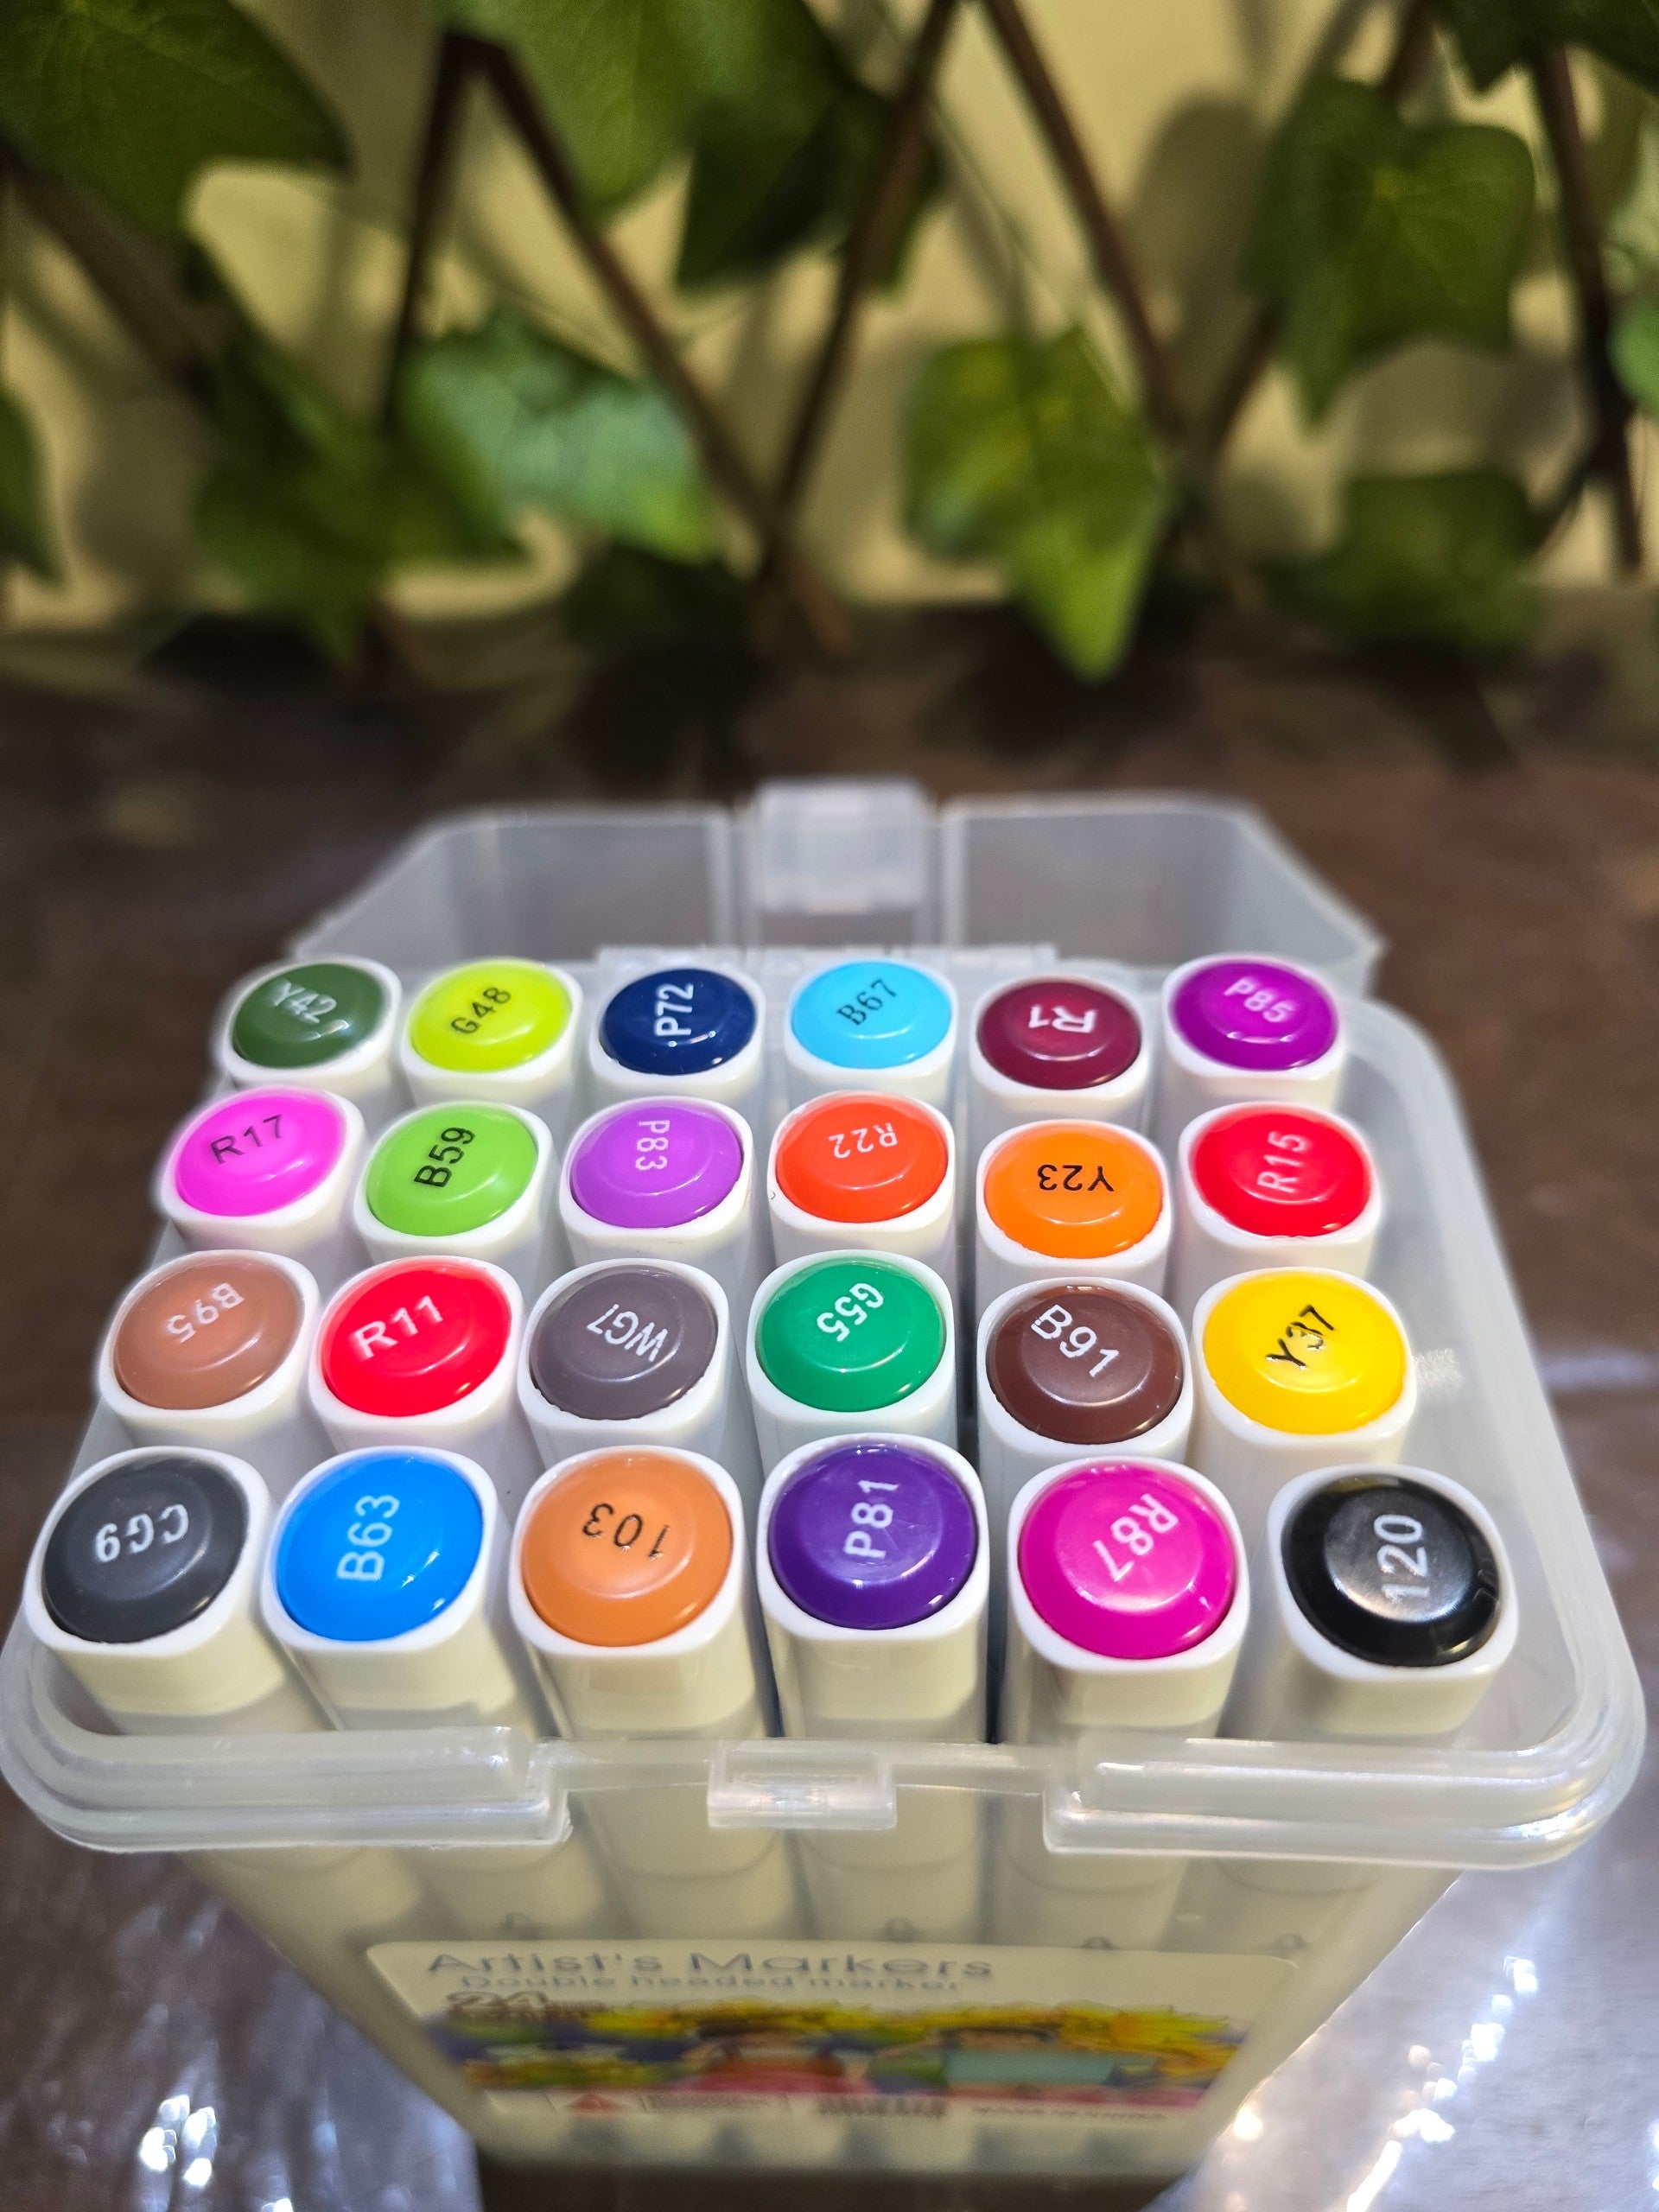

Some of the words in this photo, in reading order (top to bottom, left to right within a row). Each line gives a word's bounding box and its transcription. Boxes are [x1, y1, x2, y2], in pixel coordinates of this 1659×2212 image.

[271, 981, 337, 1024] Y42
[450, 987, 512, 1035] G48
[654, 983, 693, 1038] P72
[837, 978, 898, 1027] B67
[1028, 1004, 1095, 1033] R1
[1224, 978, 1294, 1024] P85
[210, 1115, 284, 1164] R17
[413, 1128, 475, 1188] B59
[636, 1120, 670, 1171] P83
[828, 1123, 897, 1158] R22
[1257, 1133, 1308, 1193] R15
[1037, 1164, 1114, 1192] Y23
[166, 1282, 245, 1344] B95
[353, 1295, 444, 1360] R11
[587, 1303, 668, 1363] WG7
[816, 1282, 884, 1343] G55
[1031, 1304, 1120, 1378] B91
[1266, 1304, 1336, 1370] Y37
[94, 1504, 189, 1563] CG9
[336, 1494, 400, 1581] B63
[582, 1503, 671, 1560] 103
[843, 1478, 898, 1559] P81
[1094, 1492, 1179, 1583] R87
[1375, 1514, 1428, 1600] 120
[429, 1953, 662, 1972] Artist's
[690, 1953, 992, 1977] Markers
